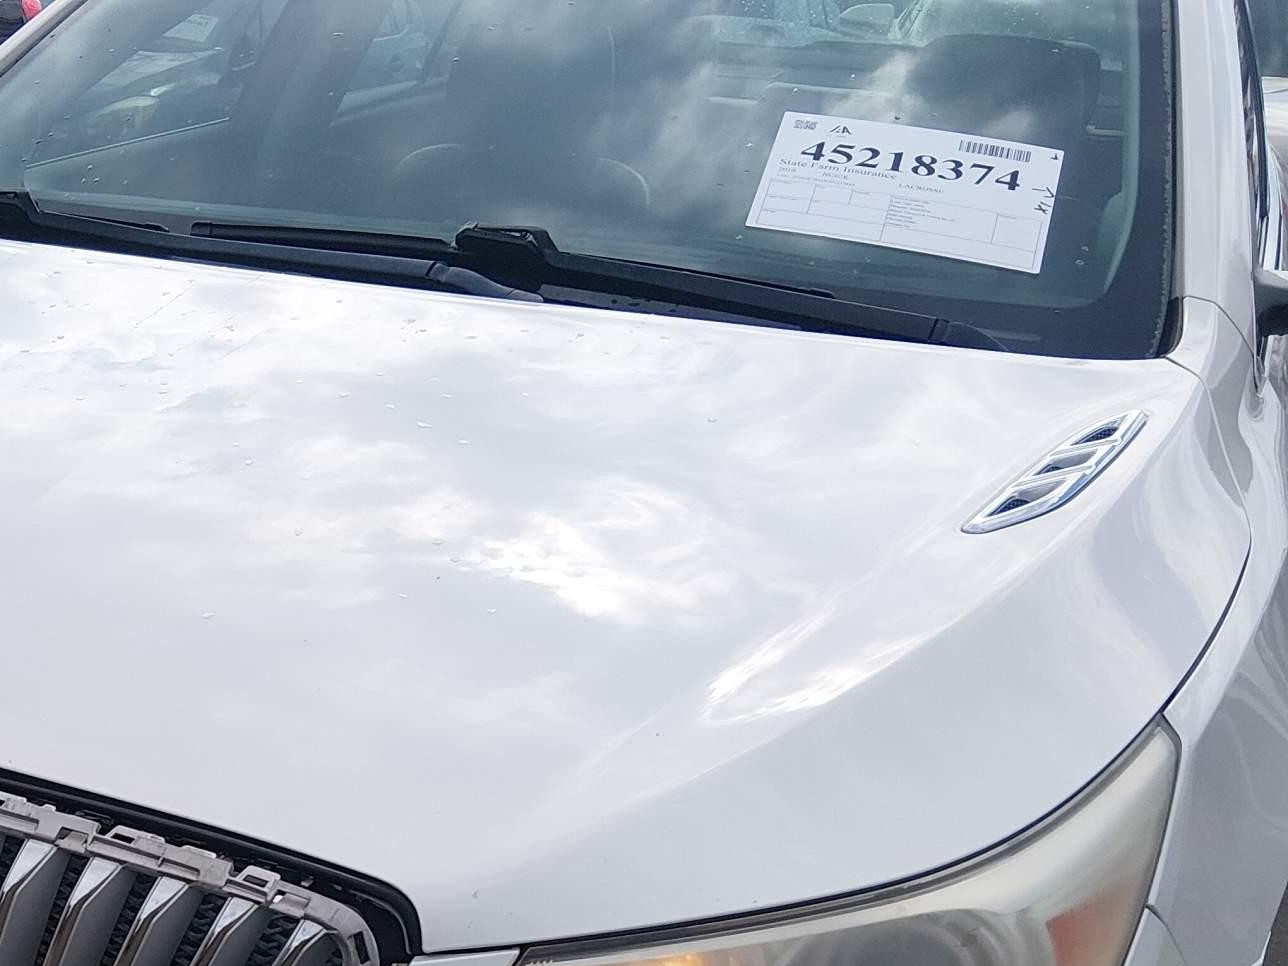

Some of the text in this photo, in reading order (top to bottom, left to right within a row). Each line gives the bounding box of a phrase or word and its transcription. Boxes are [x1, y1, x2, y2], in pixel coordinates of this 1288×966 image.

[778, 158, 808, 168] State
[811, 161, 840, 173] Farm
[843, 166, 898, 180] Insurance
[800, 141, 1021, 191] 45218374
